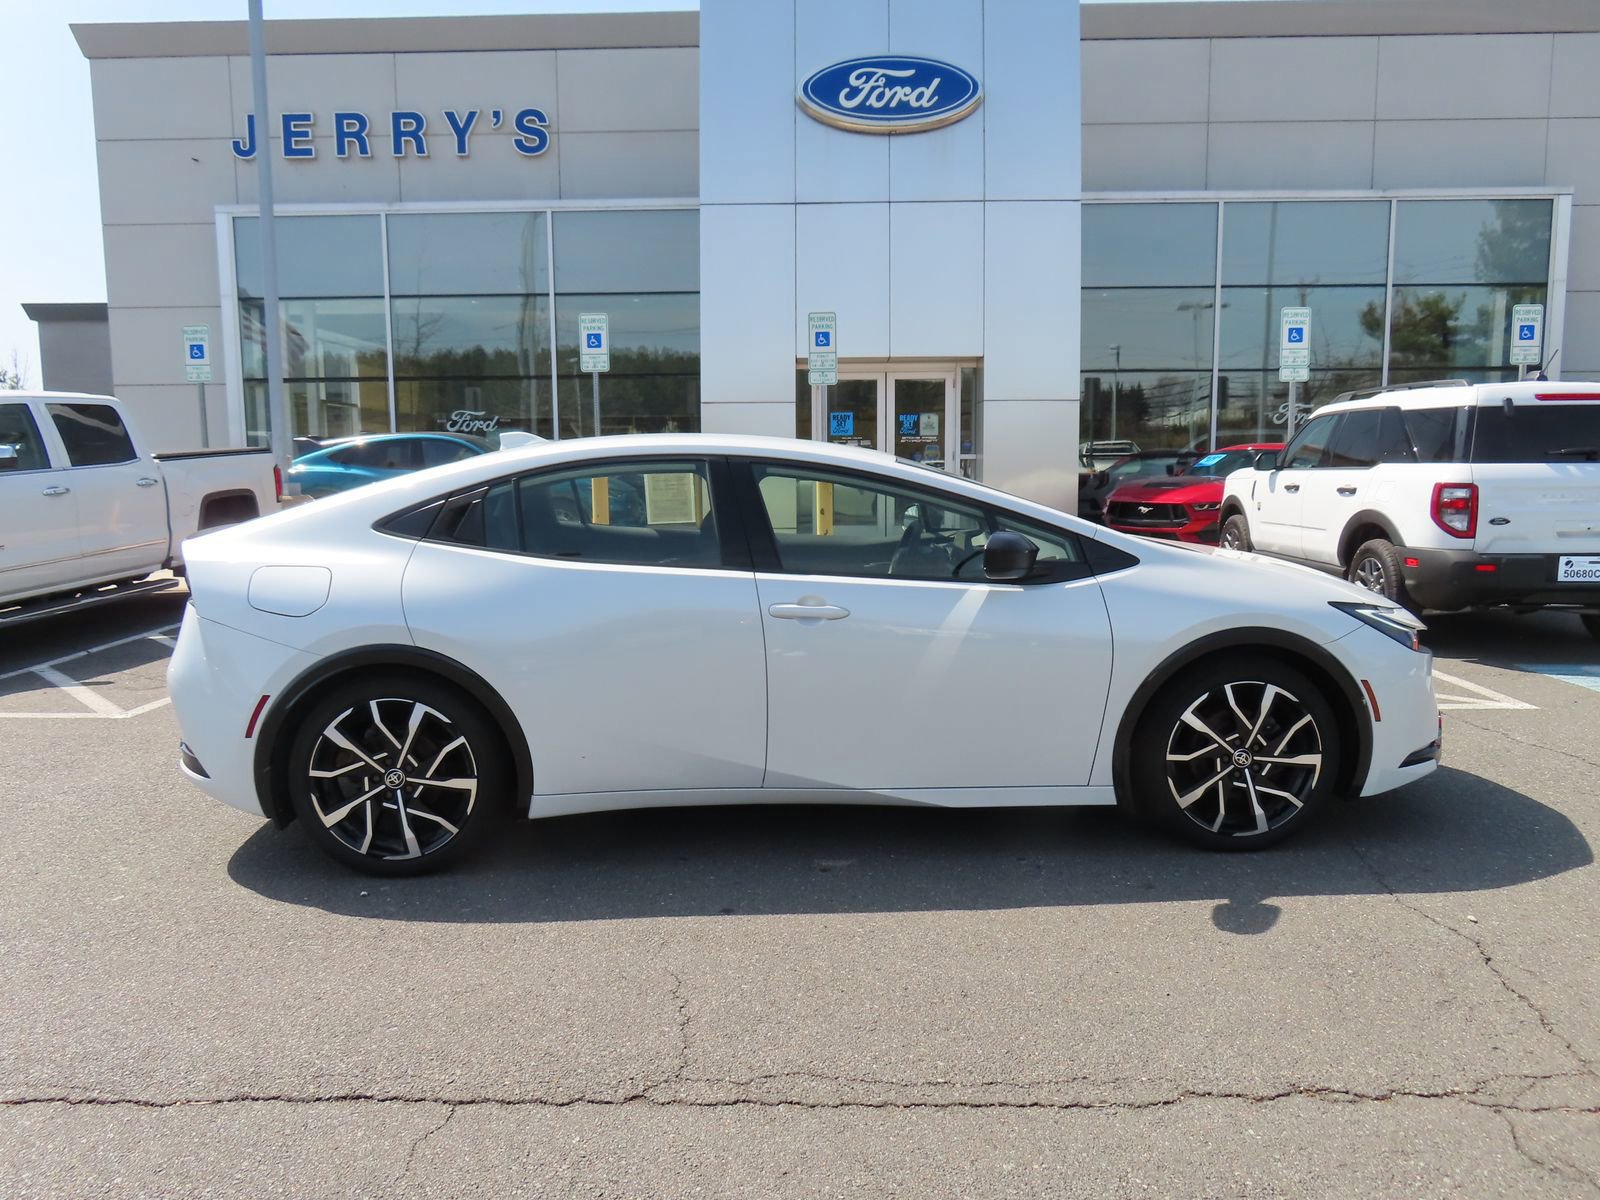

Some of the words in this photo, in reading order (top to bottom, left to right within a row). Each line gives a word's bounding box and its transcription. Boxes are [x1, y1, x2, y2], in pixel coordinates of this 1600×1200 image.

[839, 67, 941, 109] Ford
[231, 107, 550, 159] JERRY'S
[446, 410, 500, 432] Ford
